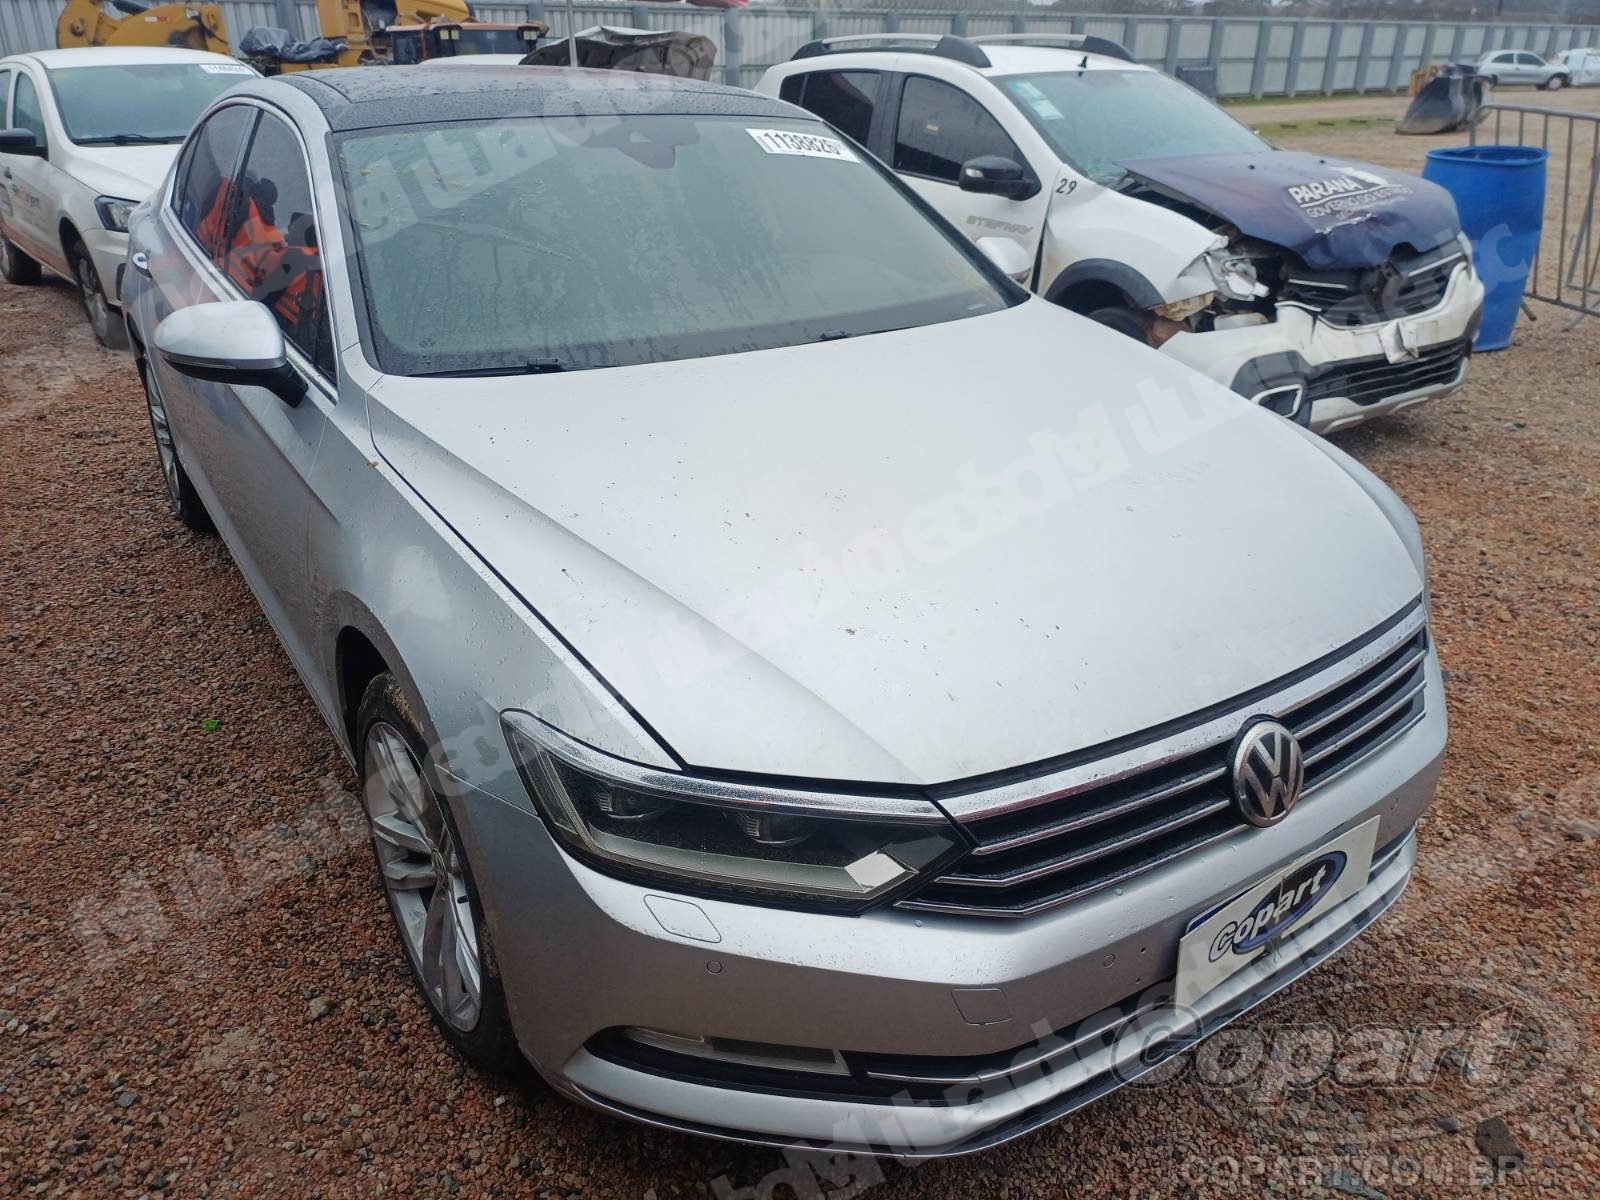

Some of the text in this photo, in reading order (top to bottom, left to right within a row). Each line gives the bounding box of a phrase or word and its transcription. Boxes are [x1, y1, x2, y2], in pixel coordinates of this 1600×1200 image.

[764, 131, 841, 155] 1138826
[1056, 178, 1077, 196] 29
[1208, 864, 1327, 963] Copart
